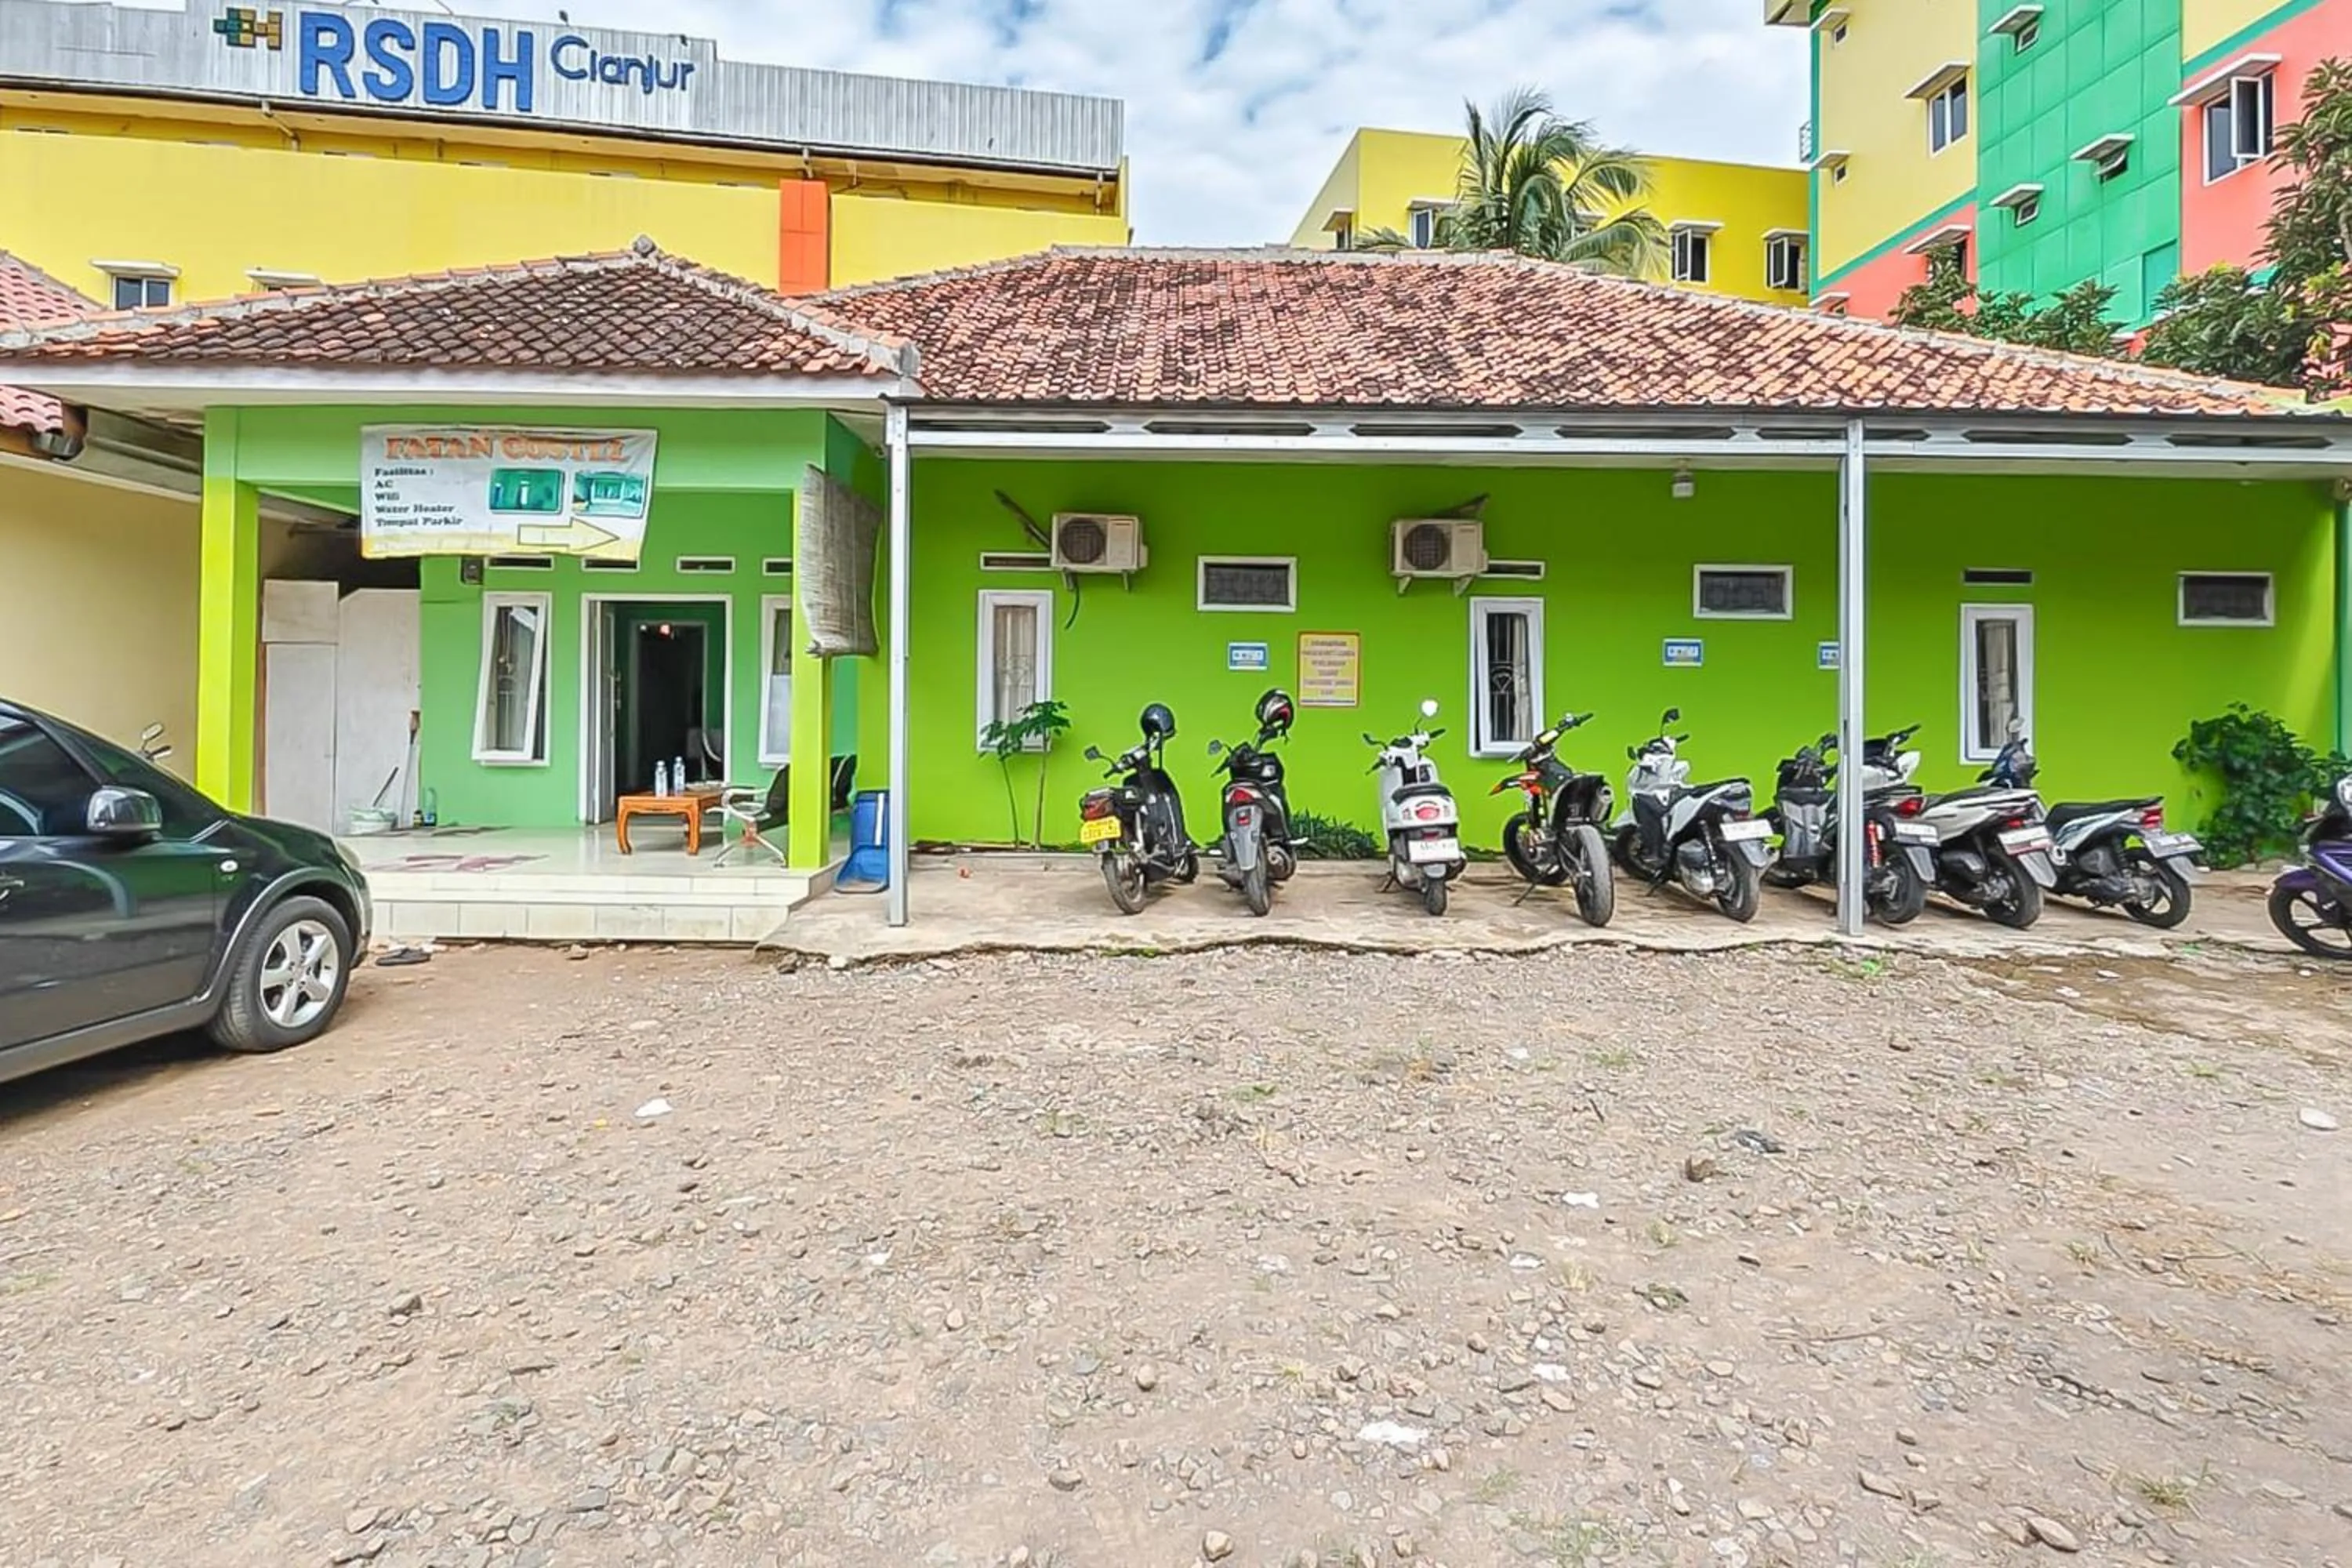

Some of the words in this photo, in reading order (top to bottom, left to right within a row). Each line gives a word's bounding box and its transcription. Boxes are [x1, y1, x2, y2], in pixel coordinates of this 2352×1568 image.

[299, 11, 534, 112] RSDH
[551, 34, 695, 94] Cianjur
[376, 480, 393, 488] AC
